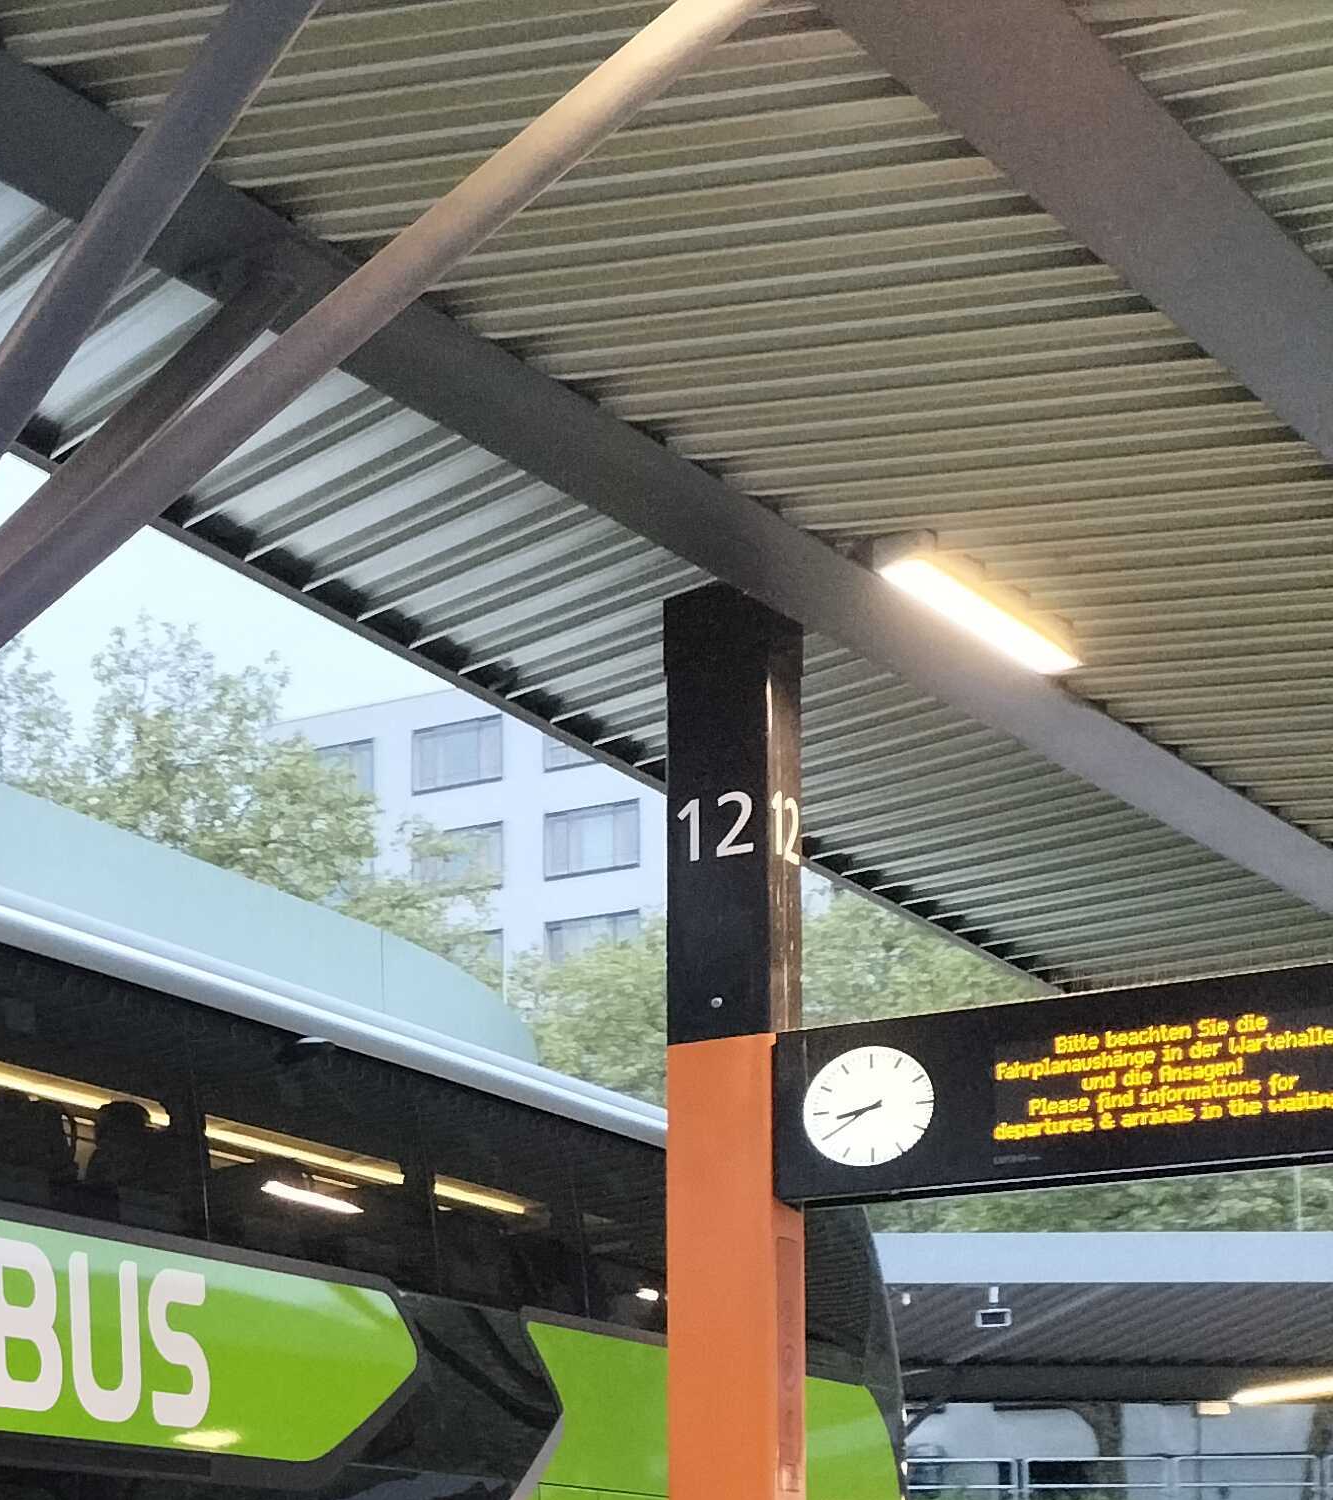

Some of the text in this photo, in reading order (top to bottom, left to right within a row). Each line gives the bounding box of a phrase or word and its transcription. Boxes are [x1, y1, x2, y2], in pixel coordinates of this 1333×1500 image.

[677, 790, 755, 862] 12
[771, 790, 800, 866] 12
[995, 1026, 1333, 1081] Fahrplanaushänge in der Wartehalle
[1054, 1013, 1269, 1054] Bitte beachten Sie die
[1028, 1073, 1300, 1117] Please find informations for
[1081, 1057, 1244, 1091] und die Ansagen!
[993, 1091, 1333, 1140] departures & arrivals in the waitin
